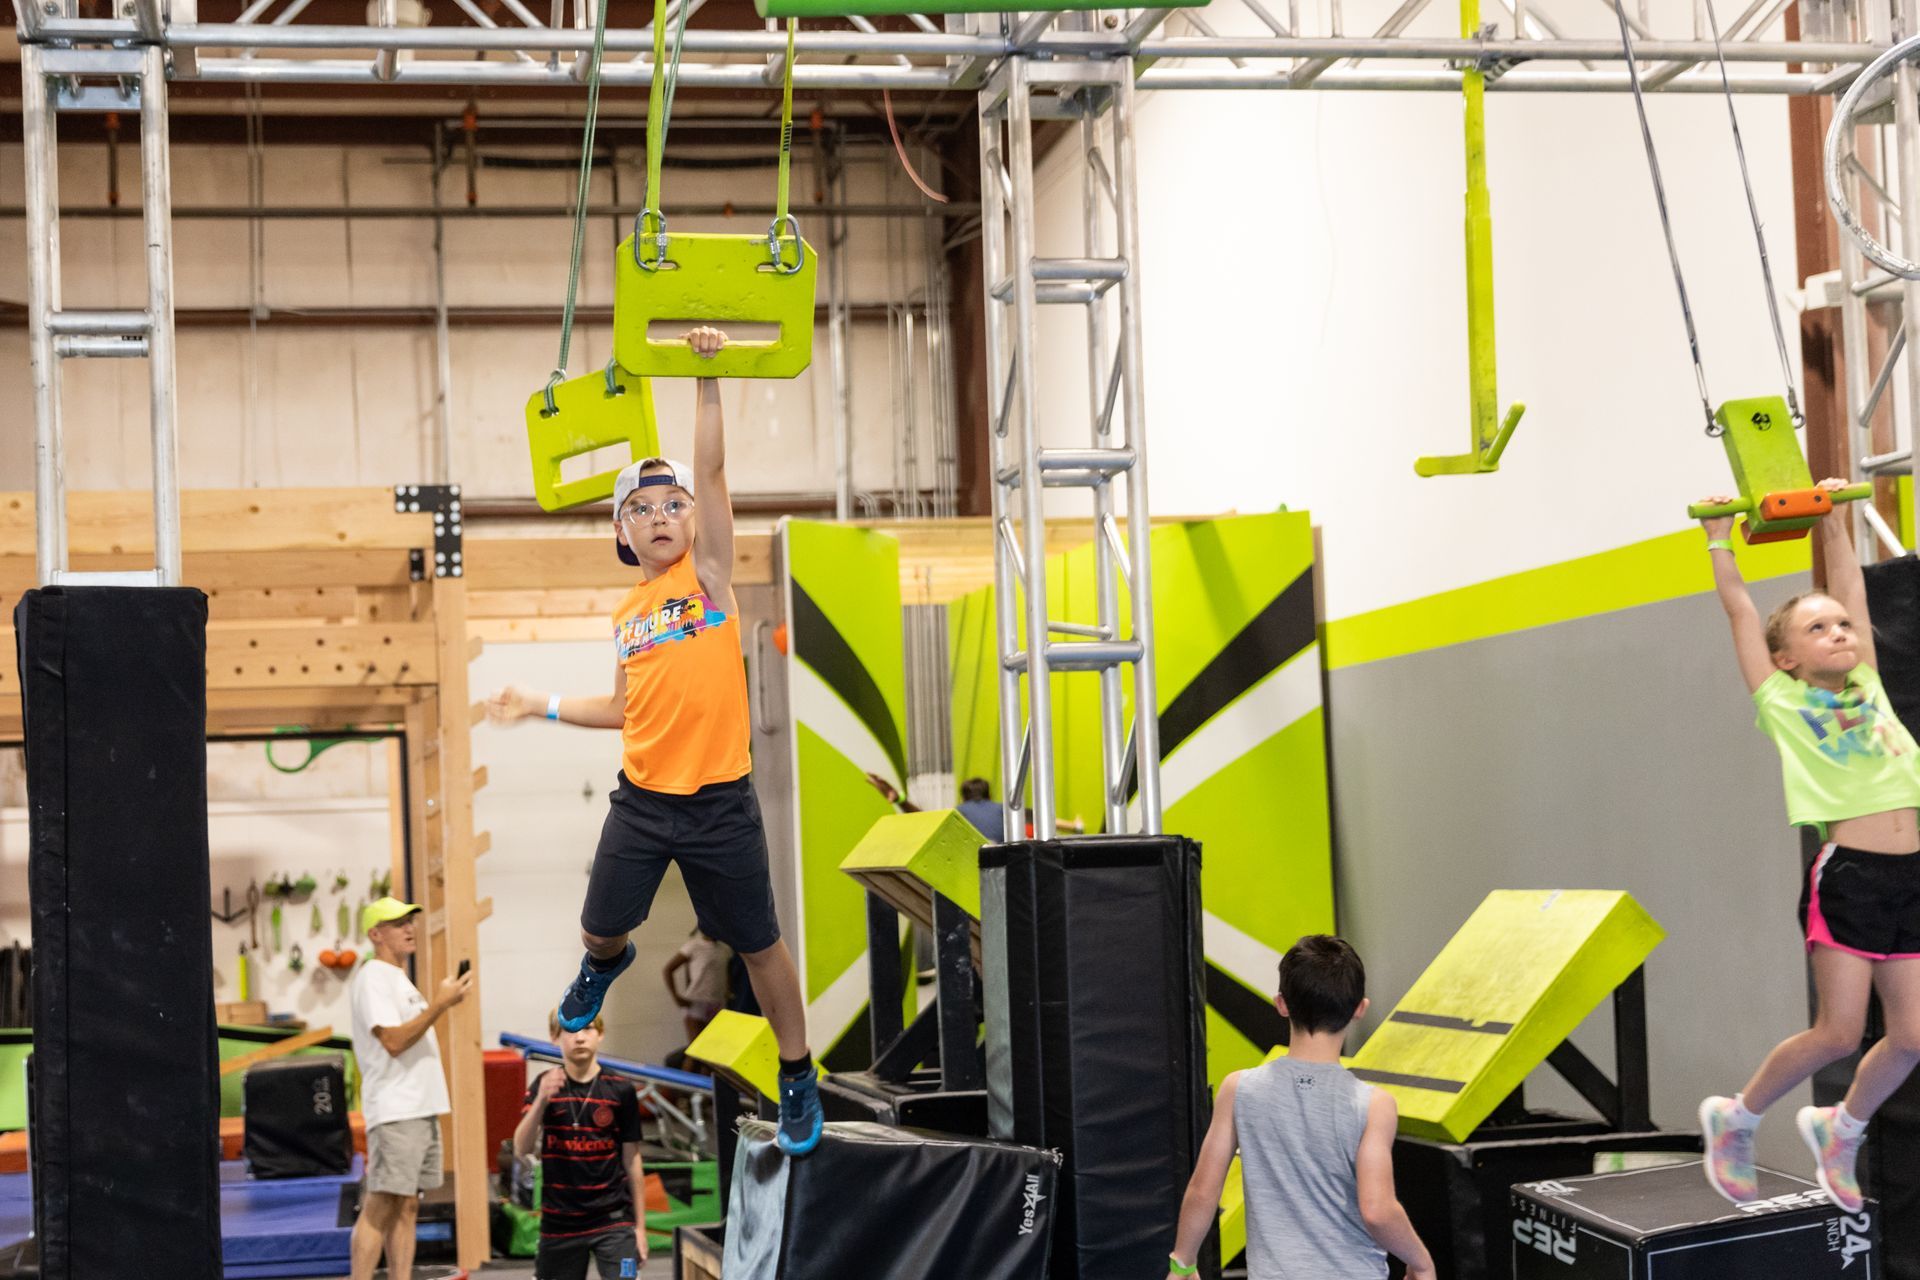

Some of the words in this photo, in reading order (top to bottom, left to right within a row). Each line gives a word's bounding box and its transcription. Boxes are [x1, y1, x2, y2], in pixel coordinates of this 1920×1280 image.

[313, 1092, 332, 1115] 20
[1018, 1173, 1047, 1236] Yes4All
[1512, 1217, 1577, 1266] REP
[1826, 1217, 1840, 1252] INCH
[1840, 1212, 1872, 1256] 24
